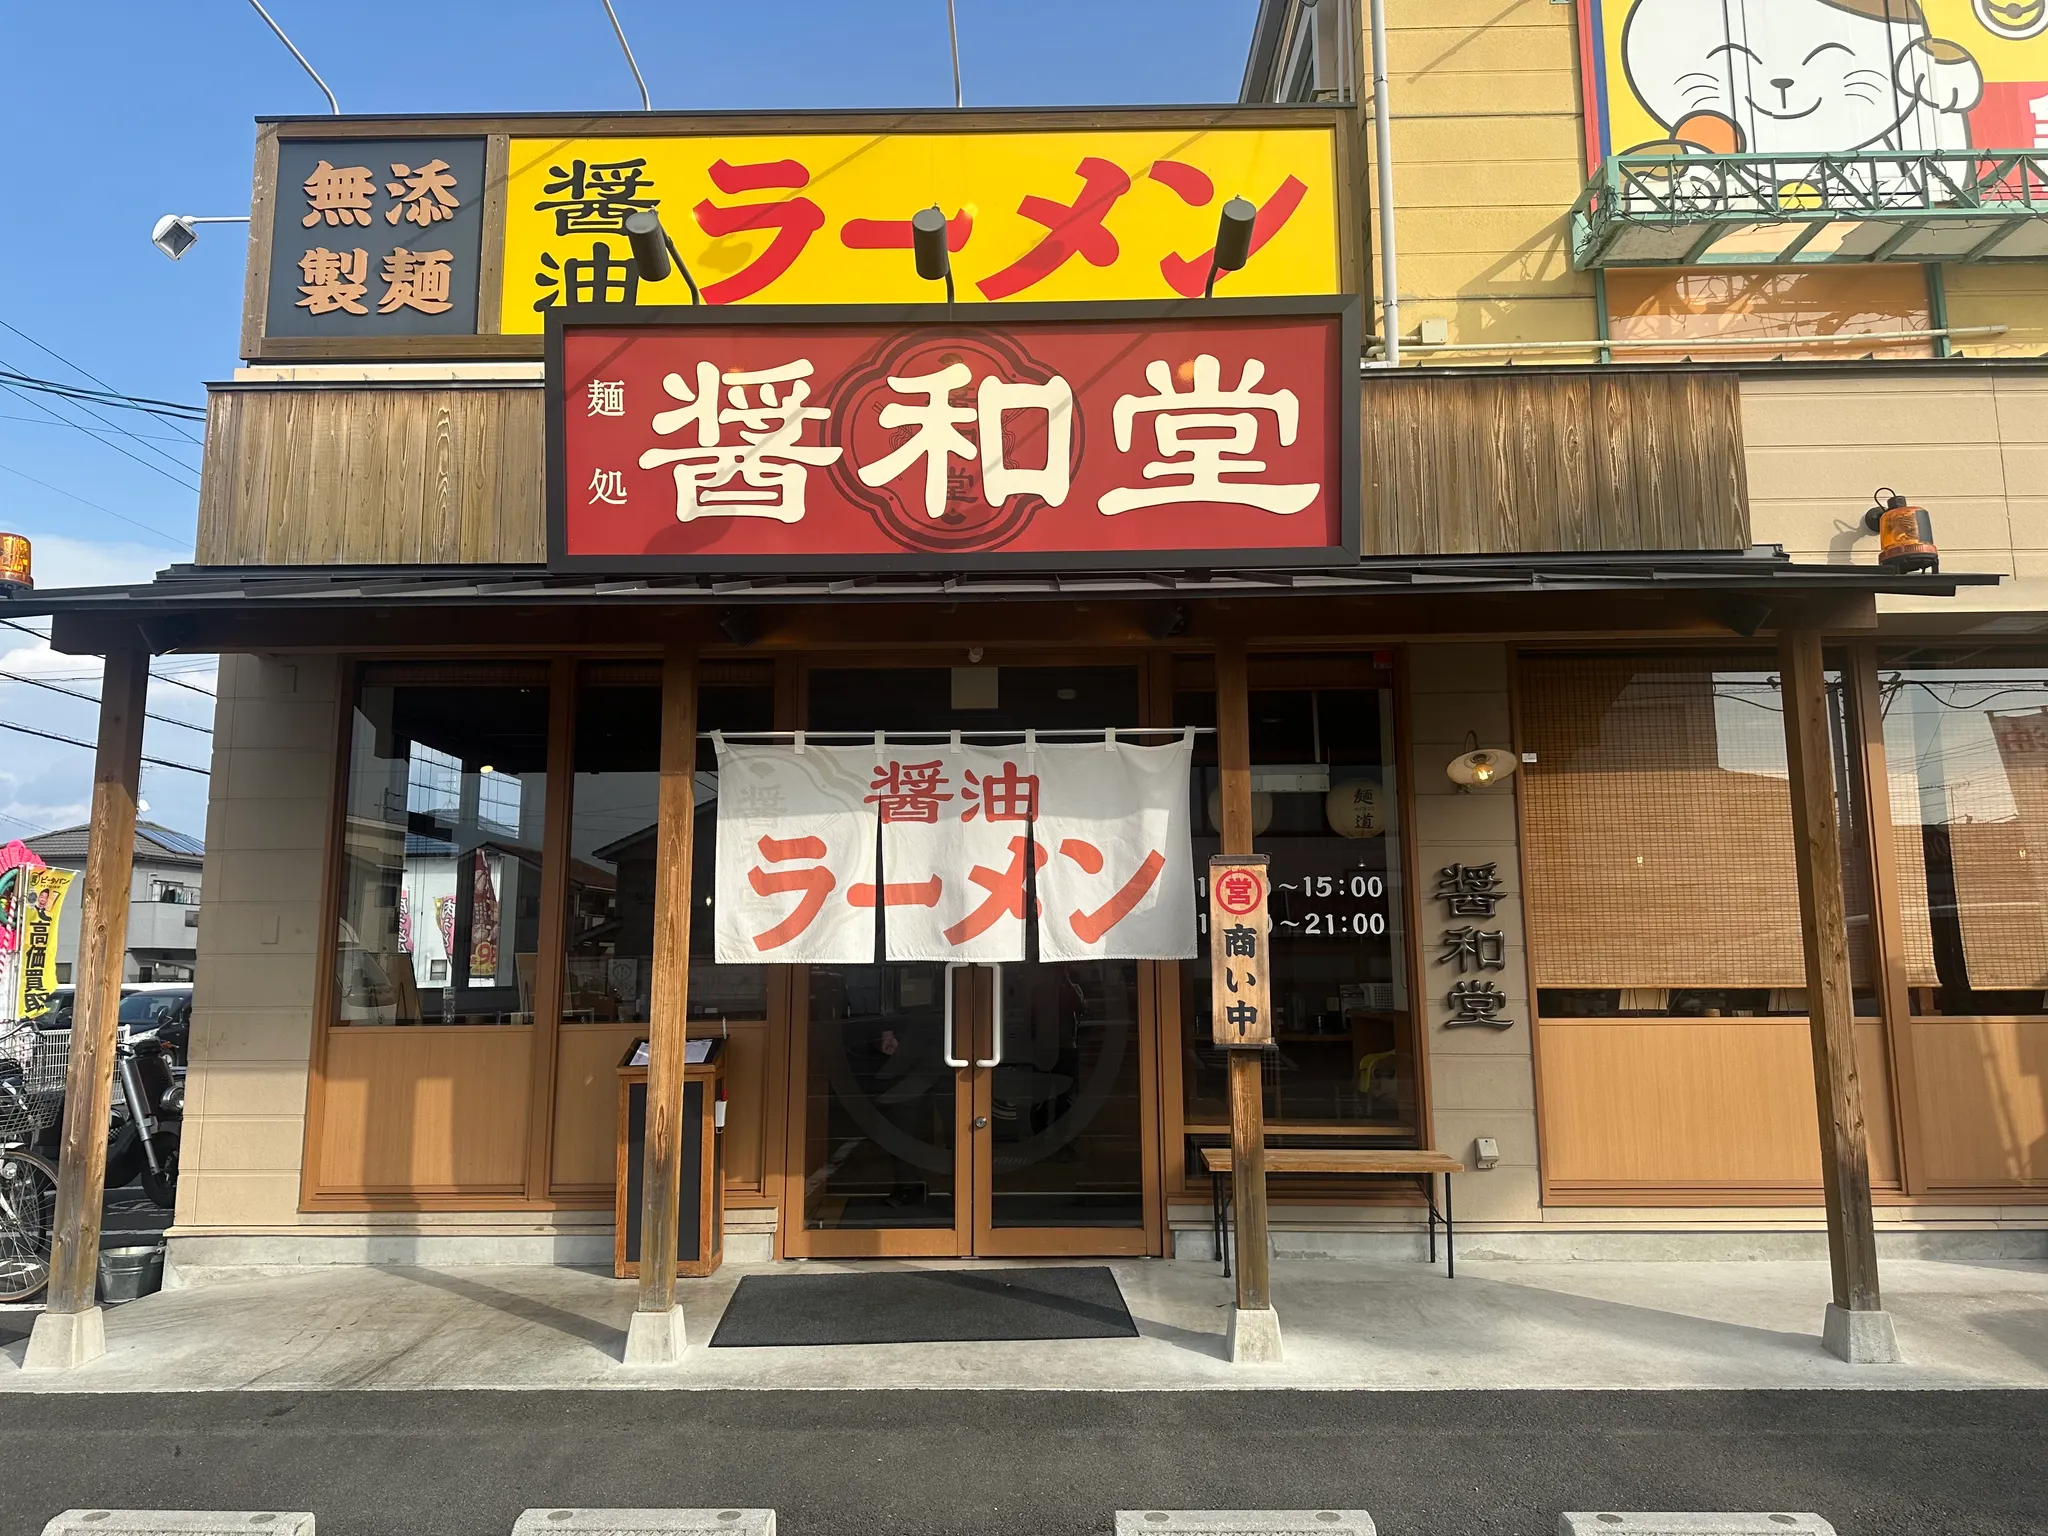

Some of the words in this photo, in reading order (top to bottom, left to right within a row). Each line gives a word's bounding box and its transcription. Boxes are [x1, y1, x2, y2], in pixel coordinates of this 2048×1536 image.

[303, 158, 459, 228] 無添
[533, 157, 661, 312] 醤油
[698, 156, 1308, 306] ラーメン
[295, 246, 455, 318] 製麺
[586, 379, 628, 506] 麺処
[638, 353, 1320, 524] 醤和堂
[863, 759, 1040, 825] 醤油
[746, 834, 1166, 952] ラーメン
[1433, 861, 1515, 1031] 醤和堂
[24, 920, 51, 1013] 高価買取
[1222, 923, 1259, 1037] 商い中
